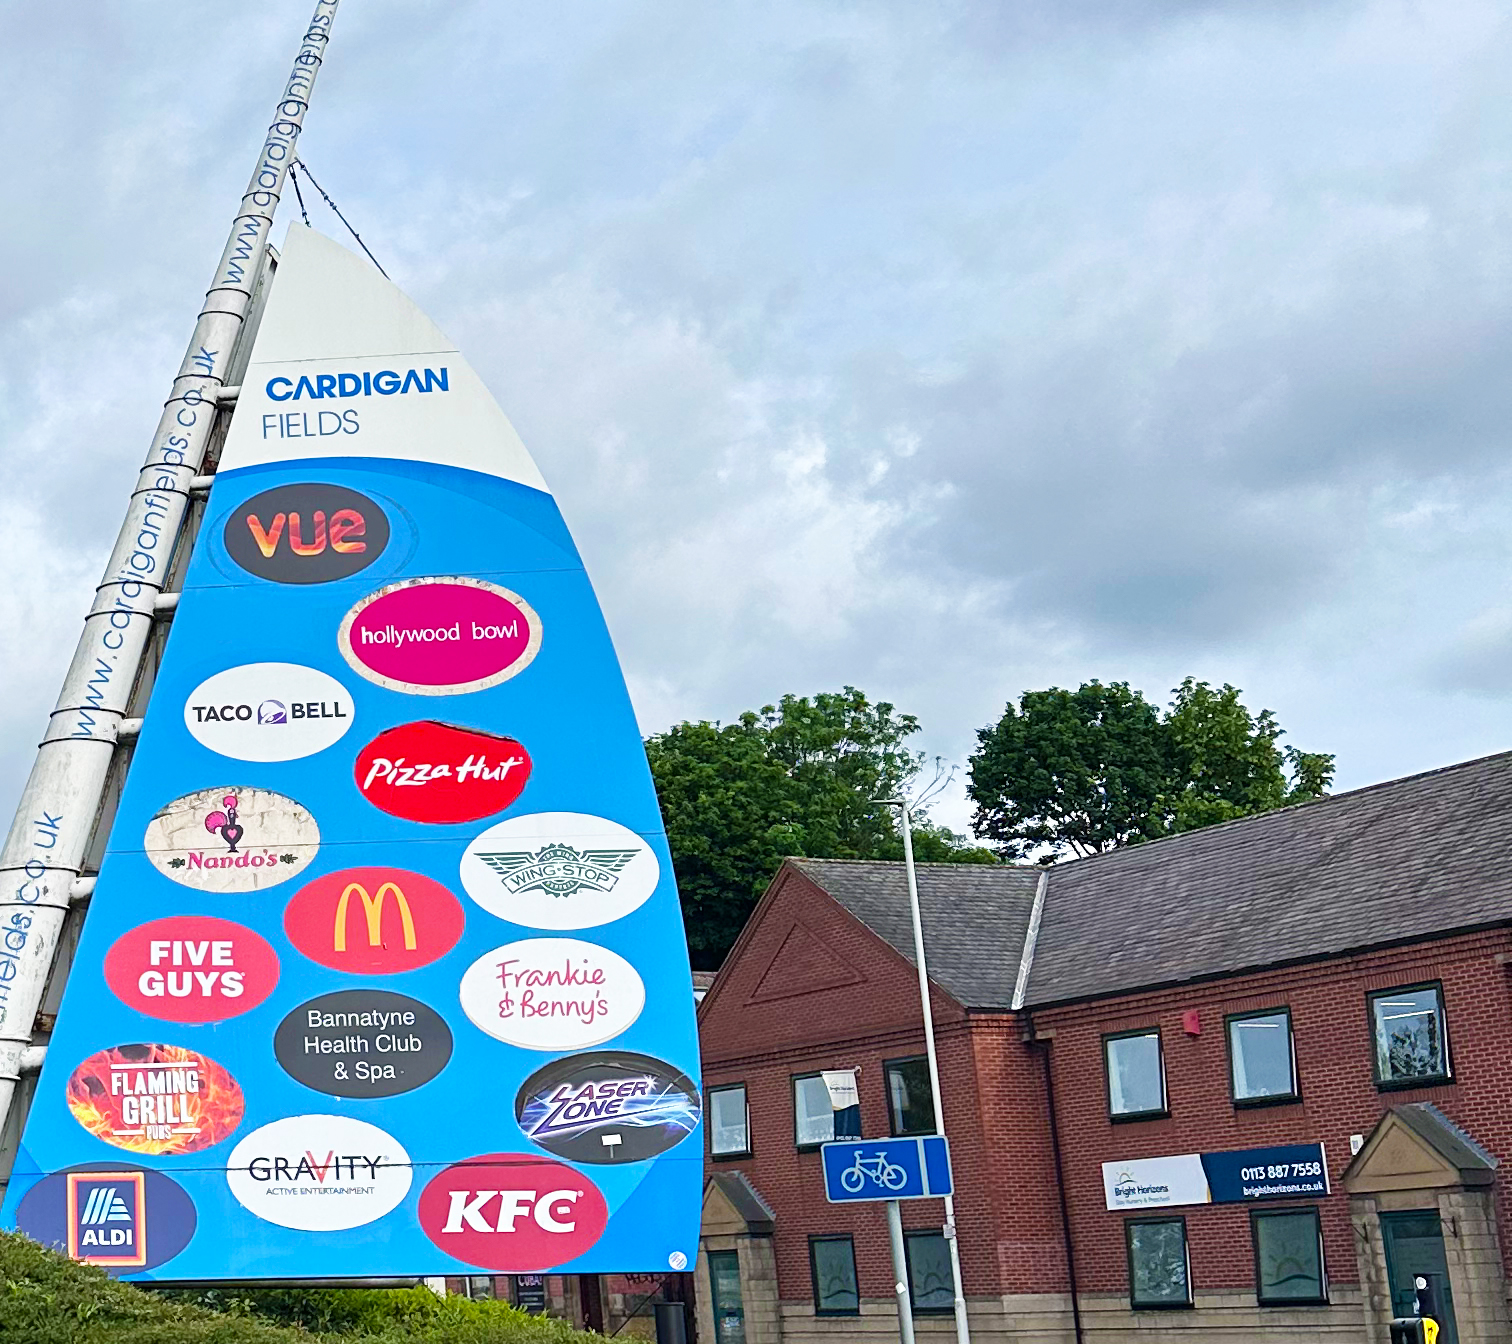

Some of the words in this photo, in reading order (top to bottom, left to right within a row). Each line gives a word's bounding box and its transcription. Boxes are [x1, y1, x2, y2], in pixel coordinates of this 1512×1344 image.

[265, 367, 450, 401] CARDIGAN
[262, 409, 360, 439] FIELDS
[71, 346, 219, 740] www.cardiganfields.co.uk
[360, 622, 461, 648] hollywood
[471, 620, 519, 641] bowl
[192, 704, 253, 722] TACO
[291, 701, 347, 719] BELL
[363, 757, 452, 790] Pizza
[455, 754, 524, 783] Hut
[186, 849, 278, 870] Nando's
[150, 941, 234, 966] FIVE
[138, 971, 244, 997] GUYS
[496, 958, 606, 989] Frankie
[520, 989, 608, 1024] Benny's
[308, 1009, 416, 1030] Bannatyne
[304, 1035, 369, 1054] Health
[375, 1033, 422, 1053] Club
[111, 1070, 199, 1096] FLAMING
[334, 1061, 349, 1080] &
[355, 1061, 396, 1083] Spa
[550, 1081, 650, 1104] LASER
[122, 1094, 194, 1125] GRILL
[146, 1124, 172, 1140] PUBS
[248, 1150, 381, 1184] GRAVITY
[1241, 1166, 1266, 1180] 0113
[1268, 1164, 1289, 1178] 887
[1291, 1161, 1322, 1176] 7558
[266, 1187, 298, 1196] ACTIVE
[300, 1186, 375, 1196] ENTERTAINMENT
[1114, 1186, 1136, 1198] Bright
[441, 1189, 579, 1233] KFC
[81, 1229, 133, 1246] ALDI
